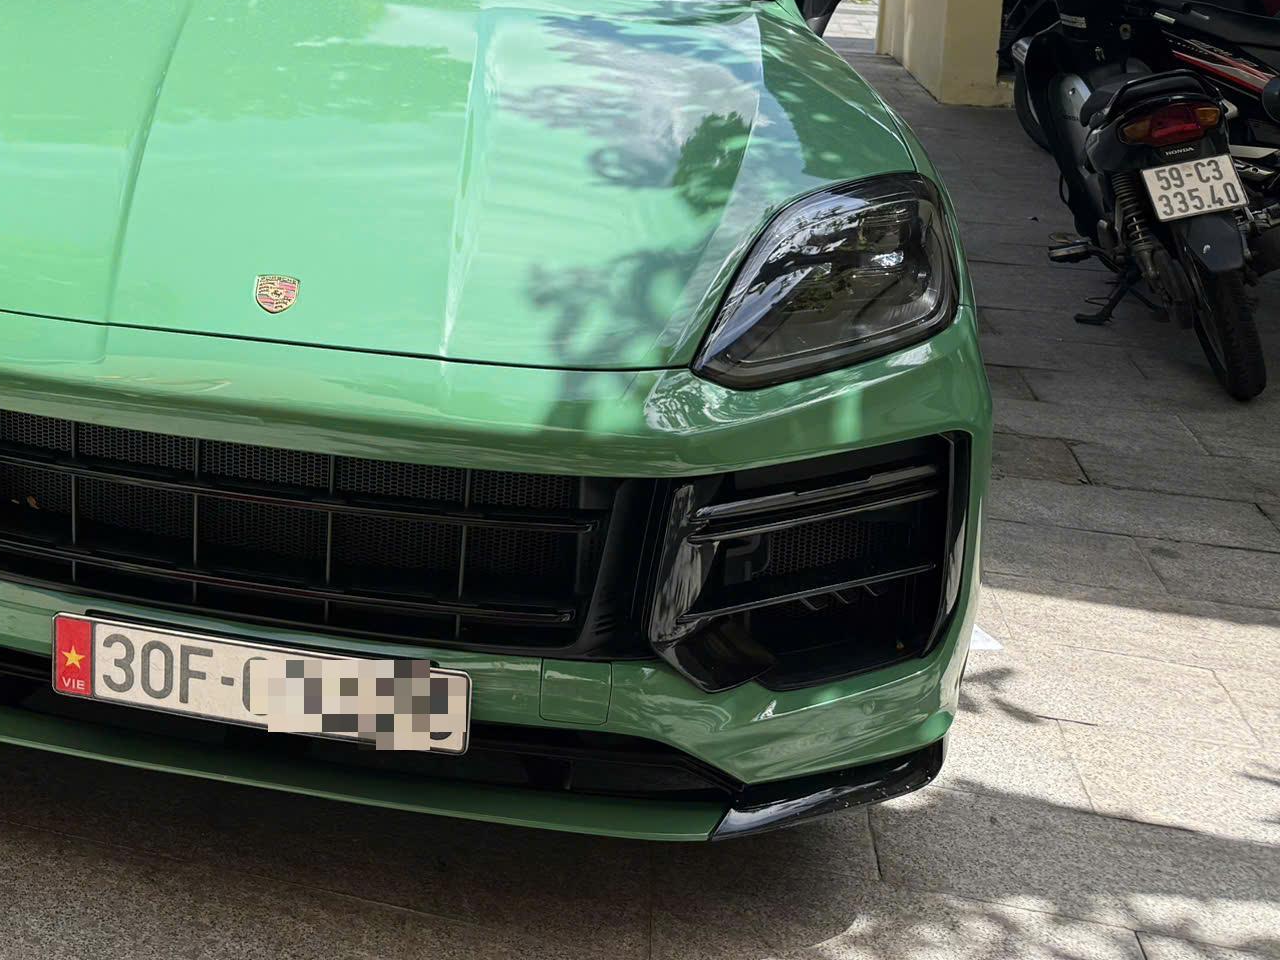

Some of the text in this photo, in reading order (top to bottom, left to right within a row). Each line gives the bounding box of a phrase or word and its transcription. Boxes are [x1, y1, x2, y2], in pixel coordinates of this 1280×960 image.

[1165, 146, 1195, 156] HONDA
[1154, 159, 1224, 191] 59-C3
[1157, 182, 1240, 217] 335.40
[61, 676, 86, 690] VIE
